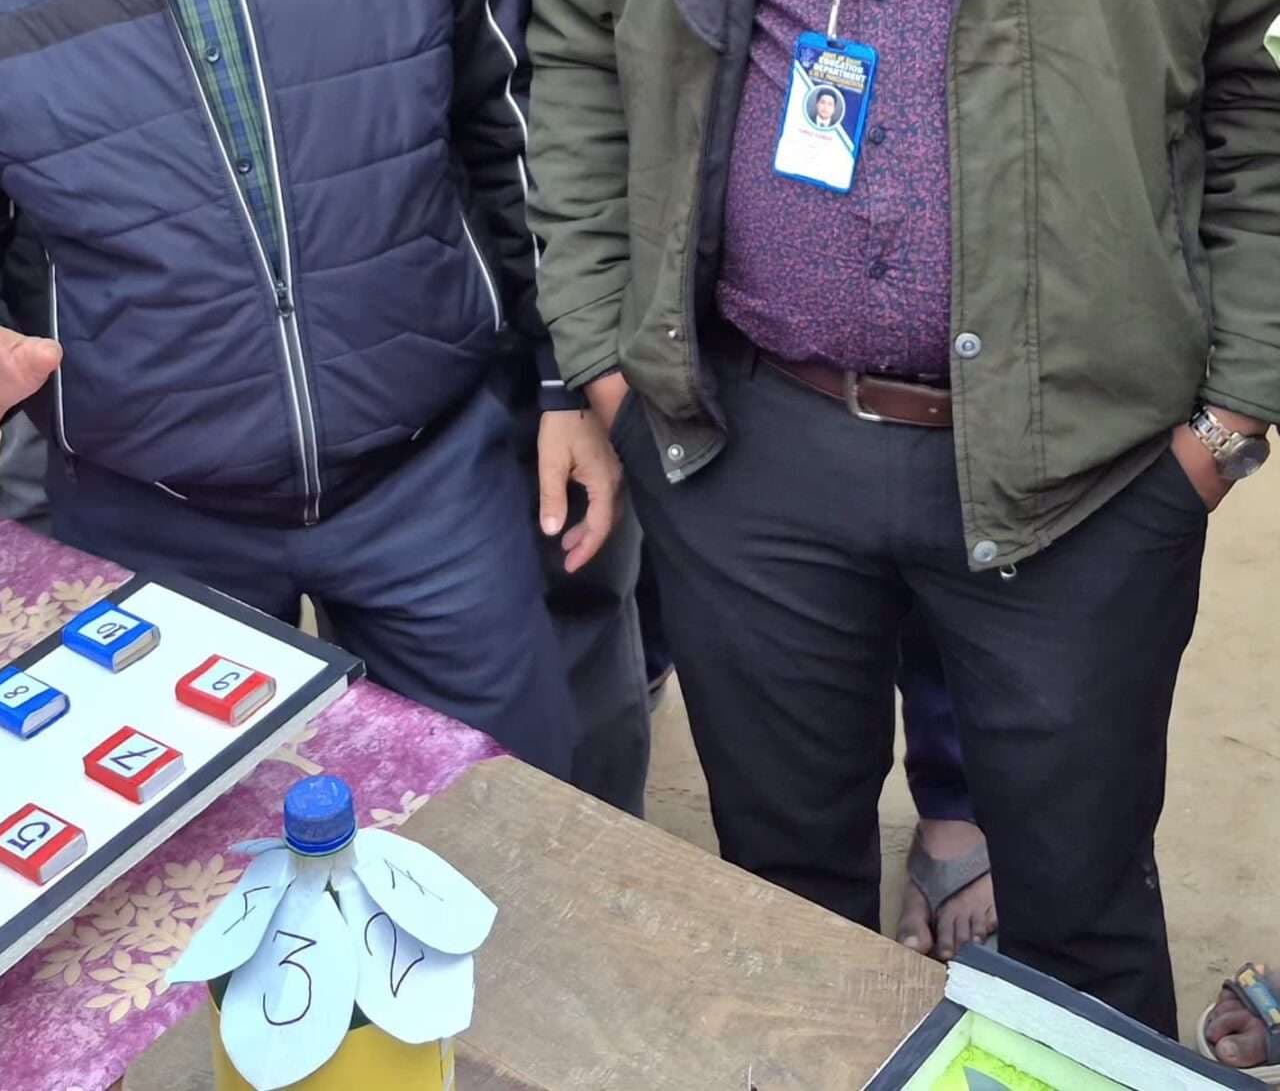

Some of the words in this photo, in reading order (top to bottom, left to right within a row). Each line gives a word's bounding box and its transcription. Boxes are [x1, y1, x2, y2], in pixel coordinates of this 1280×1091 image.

[3, 685, 30, 700] 8
[110, 746, 159, 771] 7
[6, 820, 51, 851] 5
[363, 911, 425, 998] 2
[262, 929, 318, 1026] 3
